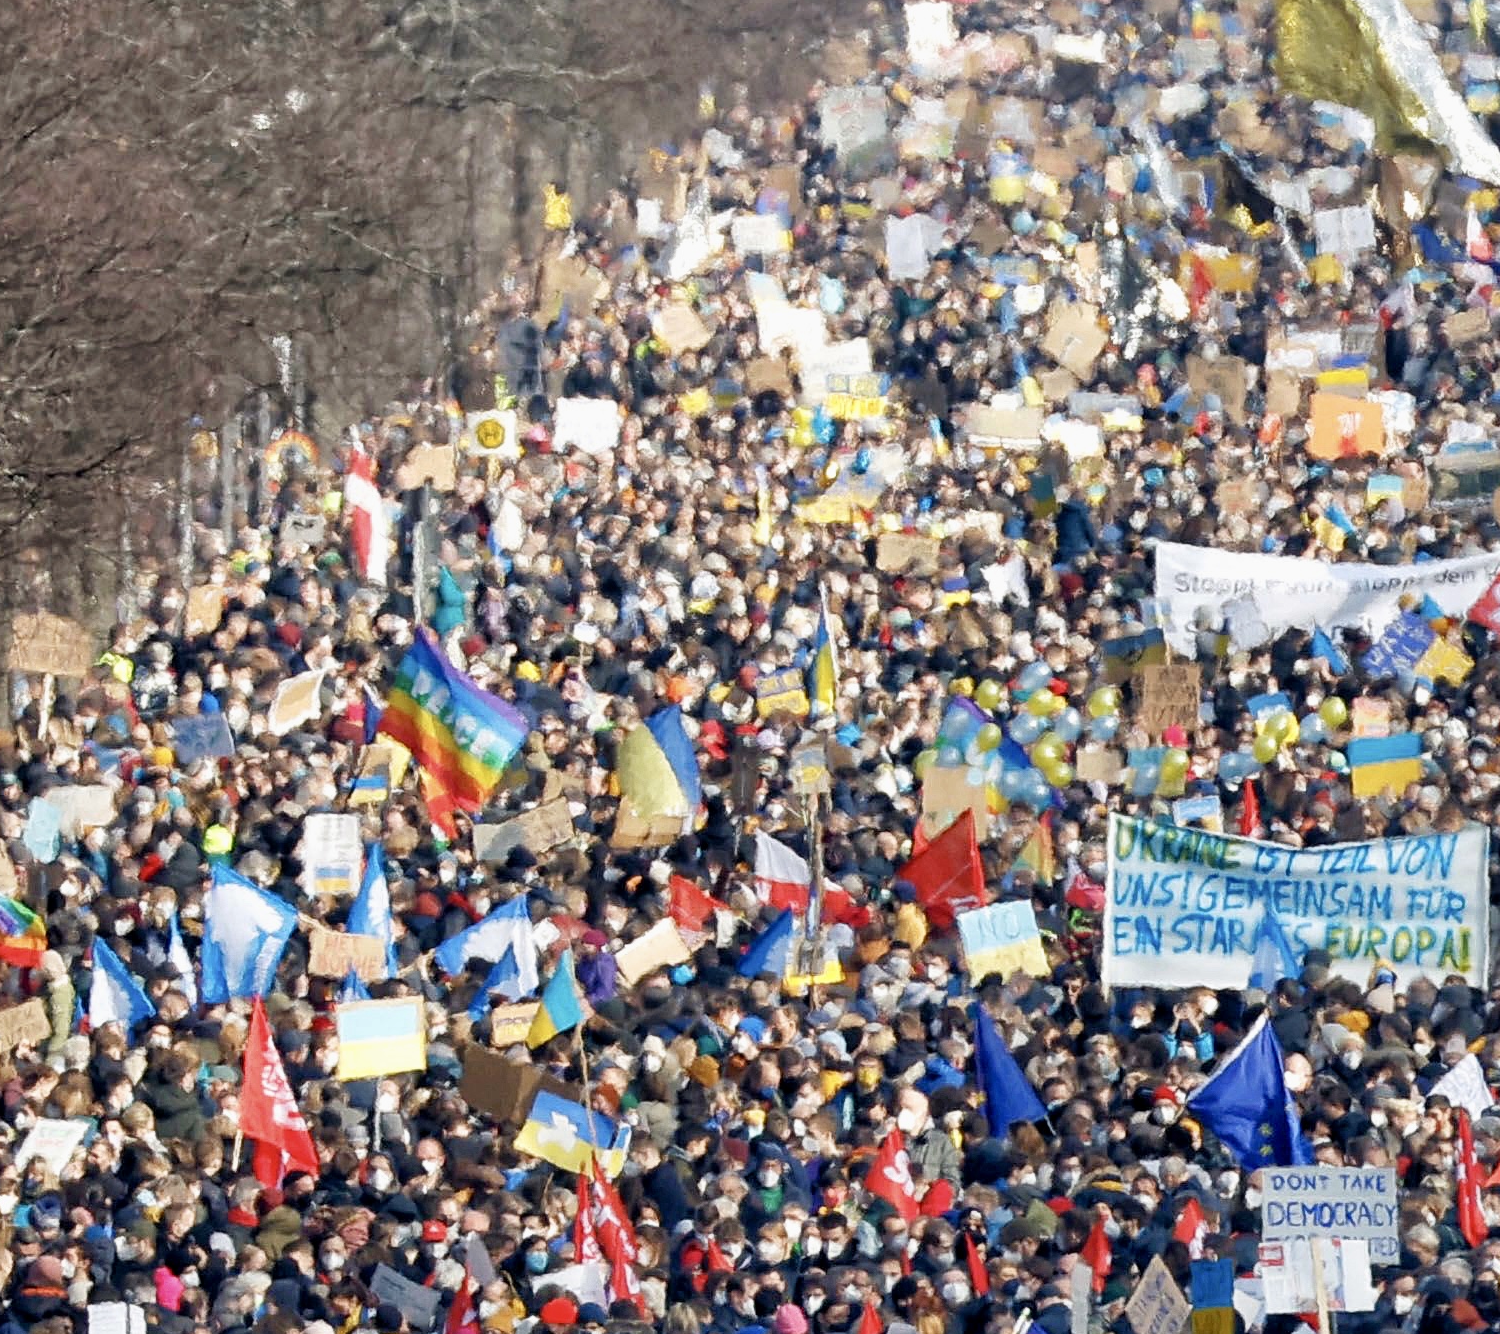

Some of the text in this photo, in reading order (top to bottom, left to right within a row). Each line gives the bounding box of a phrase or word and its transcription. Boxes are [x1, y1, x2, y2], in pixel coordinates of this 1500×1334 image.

[1438, 569, 1474, 586] den
[1115, 823, 1457, 880] UKRAINE IST TEIL VON
[1112, 867, 1465, 924] UNS! GEMEINSAM FÜR
[1113, 915, 1472, 972] EIN STARS EUROPA!
[1340, 1174, 1386, 1193] TAKE
[1267, 1202, 1396, 1228] DEMOCRACY
